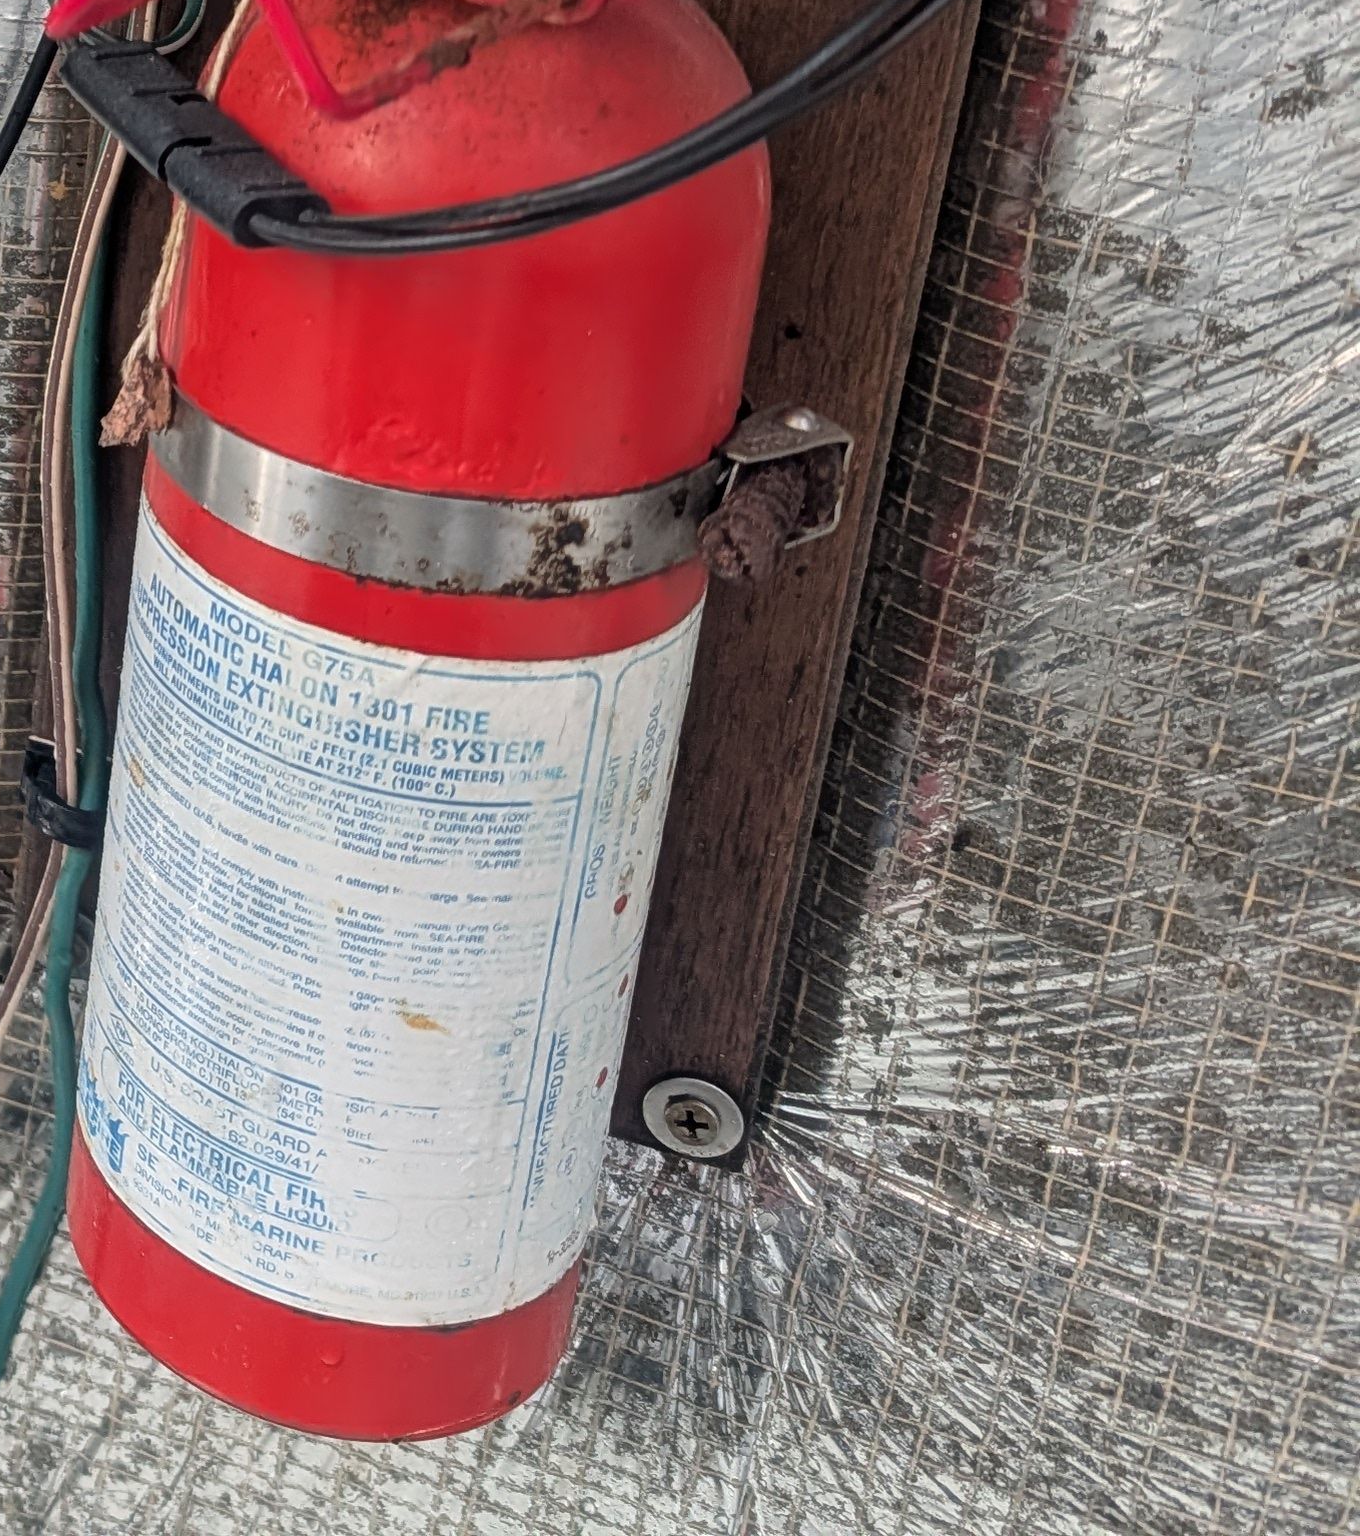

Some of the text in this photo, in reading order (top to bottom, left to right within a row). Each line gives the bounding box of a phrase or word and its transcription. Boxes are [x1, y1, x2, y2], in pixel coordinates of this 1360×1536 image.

[150, 573, 244, 667] AUTOMATIC
[250, 652, 339, 707] HALON
[348, 691, 415, 727] 1301
[425, 706, 491, 736] FIRE
[210, 600, 292, 661] MODEL
[303, 648, 375, 688] G75A
[152, 635, 221, 706] COMPARTMENTS
[223, 695, 240, 714] UP
[242, 706, 259, 726] TO
[392, 759, 438, 780] CUBIC
[440, 767, 506, 786] METERS)
[170, 673, 254, 739] AUTOMATICALLY
[314, 752, 335, 771] AT
[429, 736, 546, 766] SYSTEM
[204, 728, 225, 750] AND
[308, 780, 326, 794] OF
[417, 806, 436, 820] TO
[438, 809, 467, 824] FIRE
[471, 810, 497, 824] ARE
[335, 814, 357, 828] not
[433, 822, 484, 836] DURING
[341, 840, 381, 859] should
[382, 849, 398, 862] be
[385, 838, 408, 852] and
[346, 876, 390, 895] attempt
[282, 944, 298, 959] Do
[215, 1075, 232, 1092] TO
[118, 1070, 146, 1113] FOR
[151, 1103, 276, 1196] ELECTRICAL
[241, 1117, 311, 1154] GUARD
[149, 1128, 269, 1212] FLAMMABLE
[228, 1210, 327, 1255] MARINE
